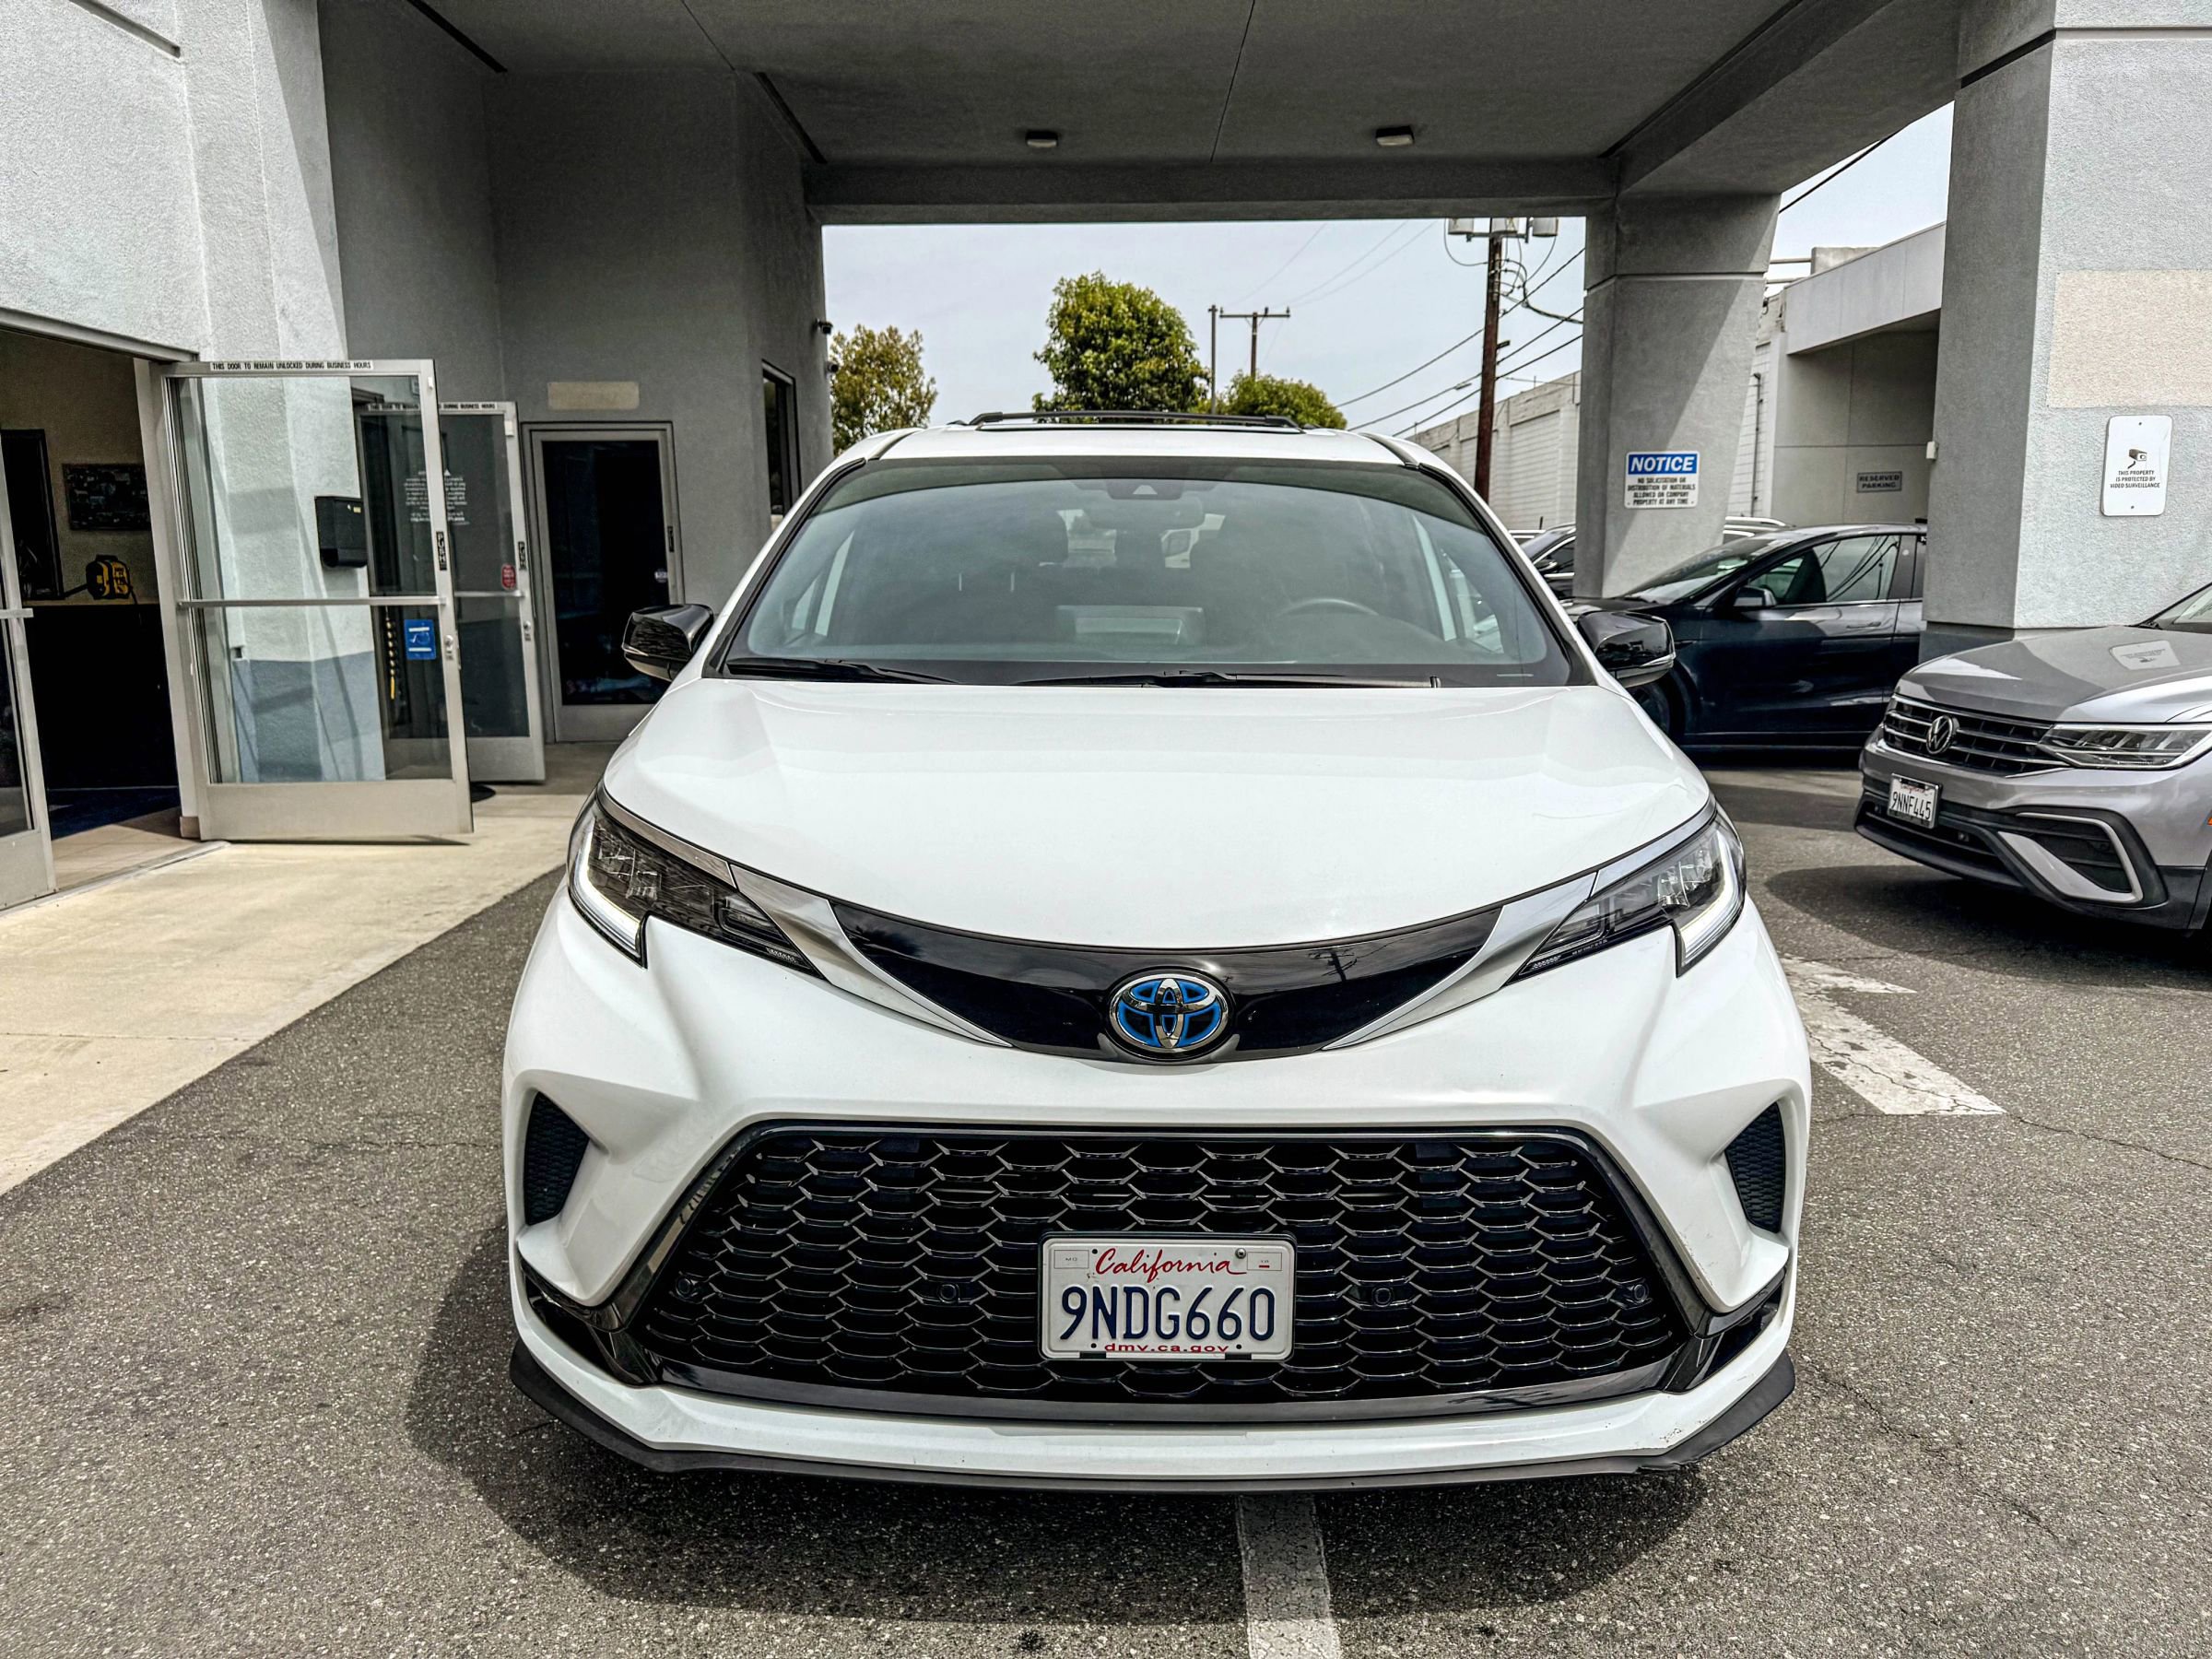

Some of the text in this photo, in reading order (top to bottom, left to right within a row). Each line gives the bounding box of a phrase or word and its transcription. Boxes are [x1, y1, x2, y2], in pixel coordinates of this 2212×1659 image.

[276, 361, 303, 370] UNLOCKED
[1630, 456, 1695, 472] NOTICE
[1892, 791, 1932, 820] 9NNF445
[1095, 1247, 1247, 1283] California
[1060, 1286, 1276, 1341] 9NDG660
[1104, 1343, 1230, 1353] dmv.ca.gov
